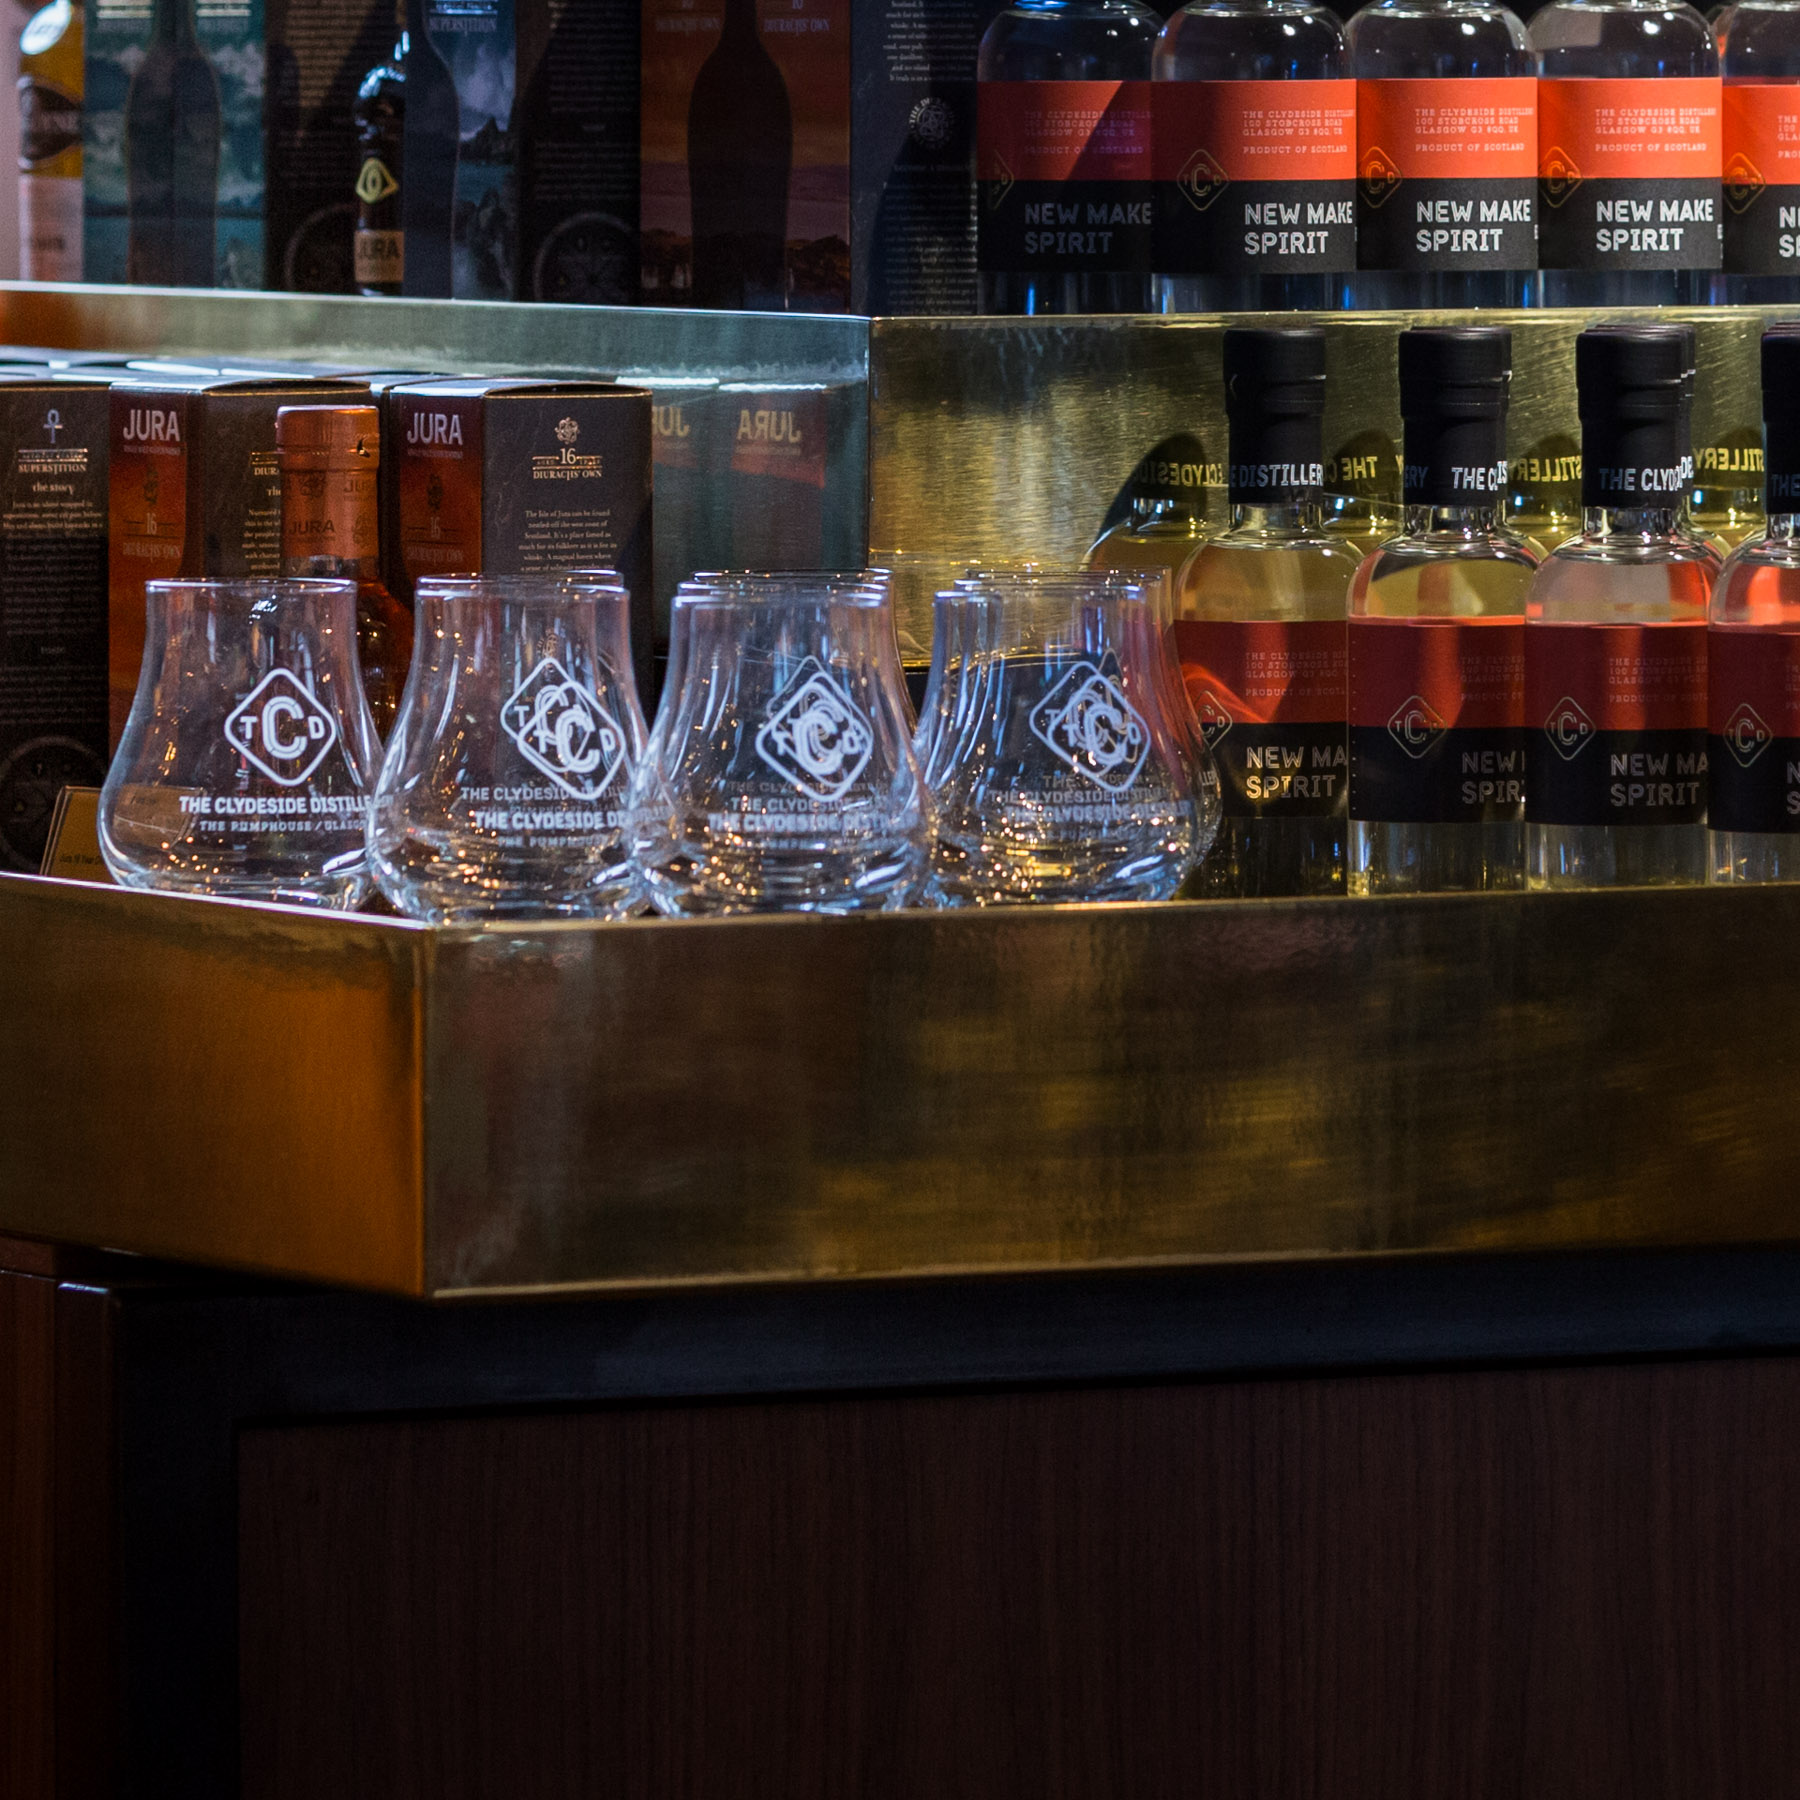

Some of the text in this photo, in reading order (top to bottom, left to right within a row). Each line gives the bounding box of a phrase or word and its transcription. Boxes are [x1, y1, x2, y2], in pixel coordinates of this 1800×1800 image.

[1415, 109, 1436, 117] THE
[1440, 108, 1495, 117] CLYDESIDE
[1437, 117, 1495, 126] STOBCROSS
[1415, 126, 1466, 135] GLASGOW
[1242, 146, 1292, 154] PRODUCT
[1295, 146, 1308, 154] OF
[1415, 143, 1525, 152] PRODUCT OF SCOTLAND
[1595, 144, 1644, 152] PRODUCT
[1647, 144, 1660, 152] OF
[1025, 203, 1151, 224] NEW MAKE
[1244, 201, 1352, 225] NEW MAKE
[1417, 199, 1531, 223] NEW MAKE
[1596, 198, 1714, 223] NEW MAKE
[1025, 232, 1114, 254] SPIRIT
[1244, 231, 1328, 254] SPIRIT
[1416, 229, 1503, 252] SPIRIT
[1596, 228, 1684, 251] SPIRIT
[123, 409, 180, 442] JURA
[407, 412, 463, 446] JURA
[560, 448, 577, 465] 16
[1451, 466, 1487, 489] THE
[1772, 474, 1800, 496] THE
[289, 520, 335, 536] JURA
[1247, 747, 1304, 768] NEW
[1462, 751, 1514, 773] NEW
[1611, 754, 1668, 776] NEW
[1247, 775, 1336, 798] SPIRIT
[1611, 782, 1699, 806] SPIRIT
[180, 796, 212, 814] THE
[214, 797, 308, 814] CLYDESIDE
[200, 821, 226, 831] THE
[475, 812, 602, 830] THE CLYDESIDE
